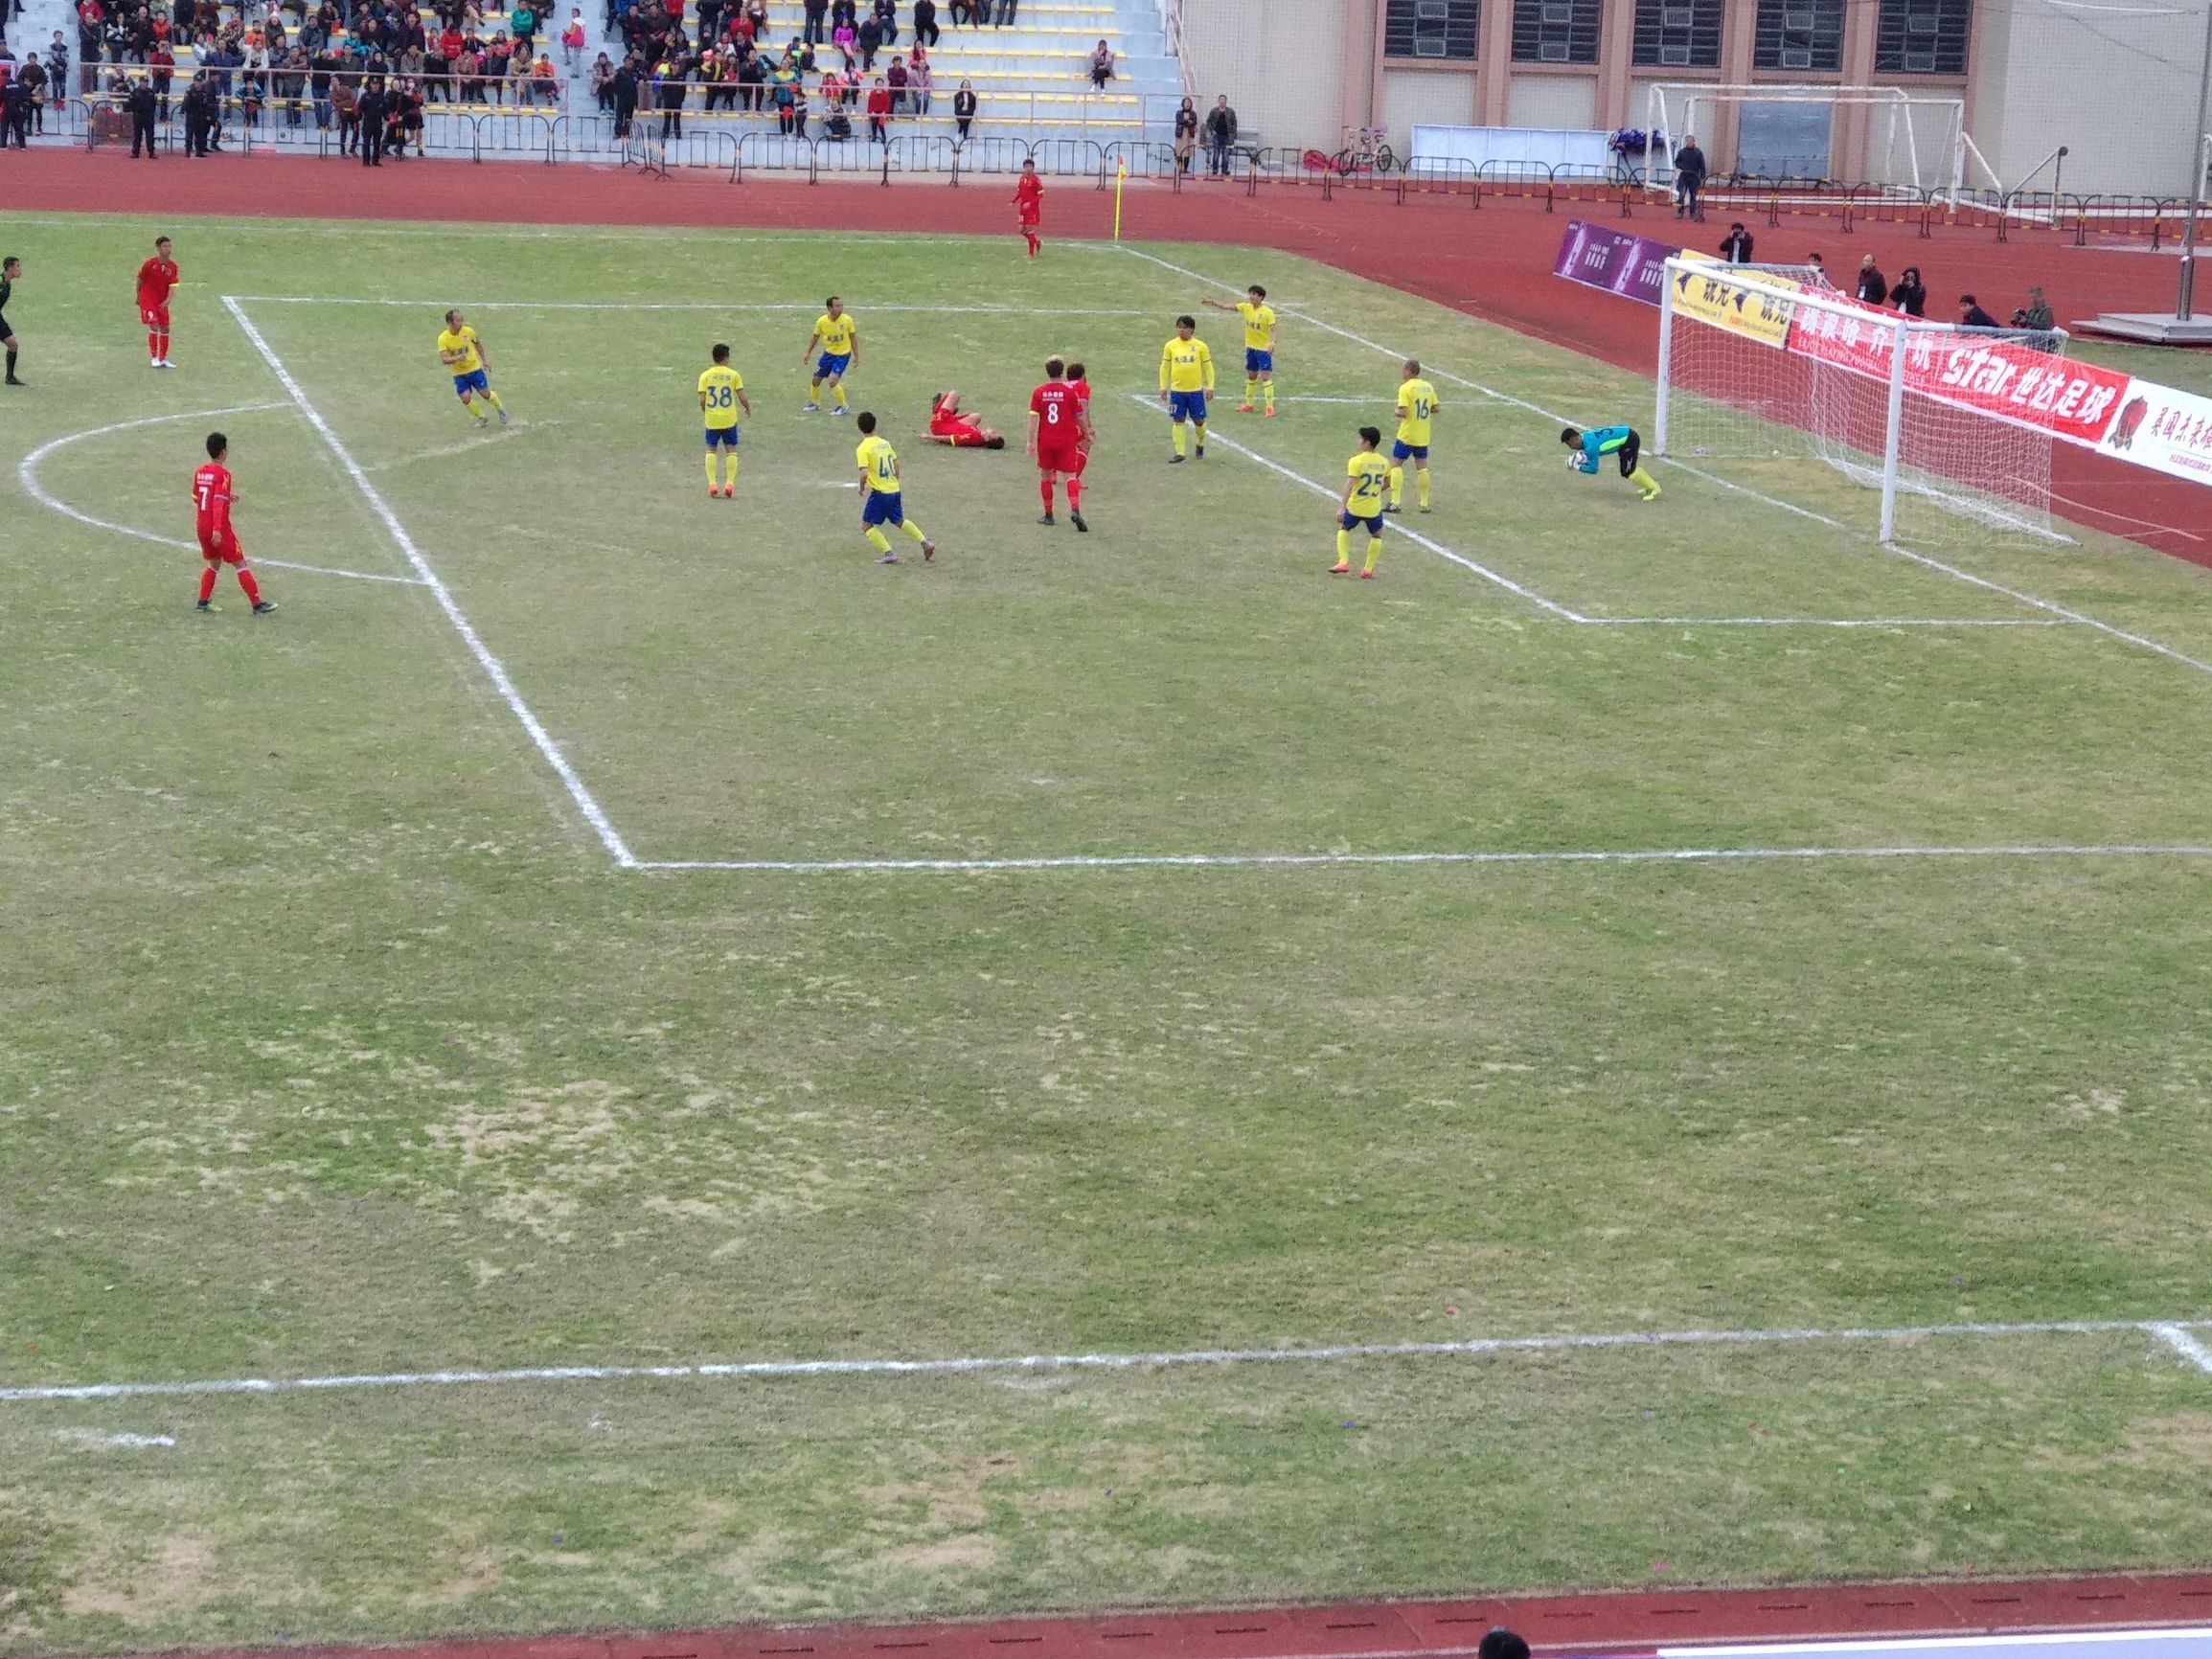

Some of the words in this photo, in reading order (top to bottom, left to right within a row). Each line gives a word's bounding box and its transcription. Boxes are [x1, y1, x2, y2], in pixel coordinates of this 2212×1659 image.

[707, 385, 732, 408] 38
[2010, 366, 2117, 424] 世达足球
[1047, 402, 1059, 424] 8
[1415, 398, 1429, 420] 16
[1357, 472, 1383, 497] 25
[198, 486, 208, 511] 7
